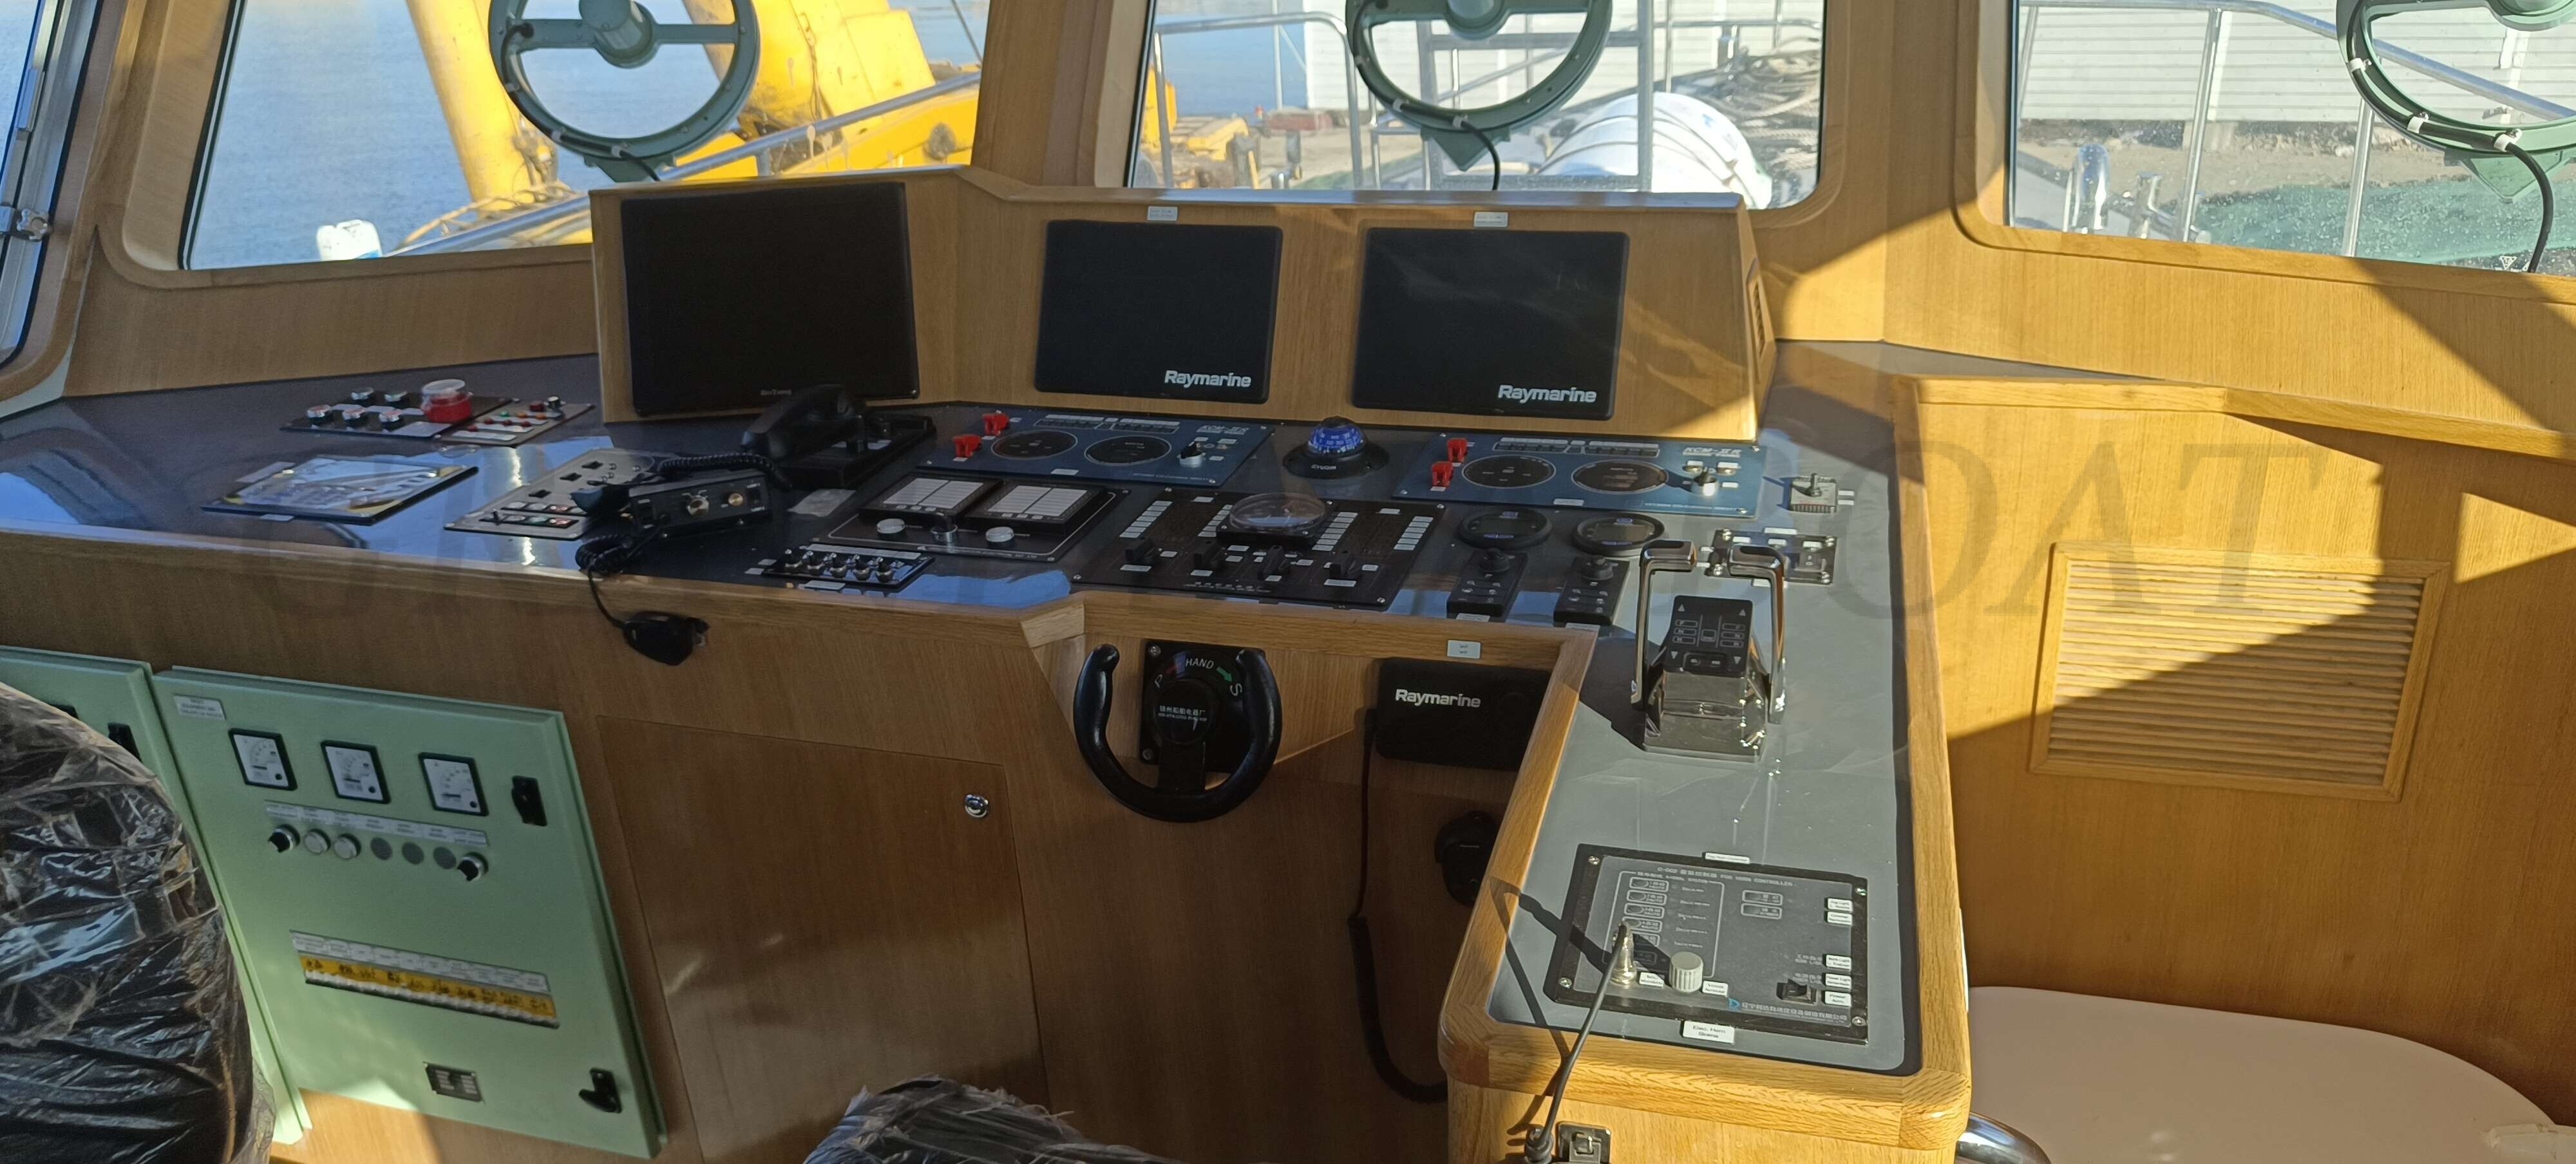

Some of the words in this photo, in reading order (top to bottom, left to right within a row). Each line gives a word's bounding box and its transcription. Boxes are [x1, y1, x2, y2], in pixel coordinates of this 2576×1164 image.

[1164, 370, 1251, 388] Raymarine
[1498, 384, 1596, 403] Raymarine
[1186, 658, 1215, 670] HAND
[1154, 674, 1163, 688] P
[1229, 682, 1243, 696] S
[1395, 689, 1481, 708] Raymarine
